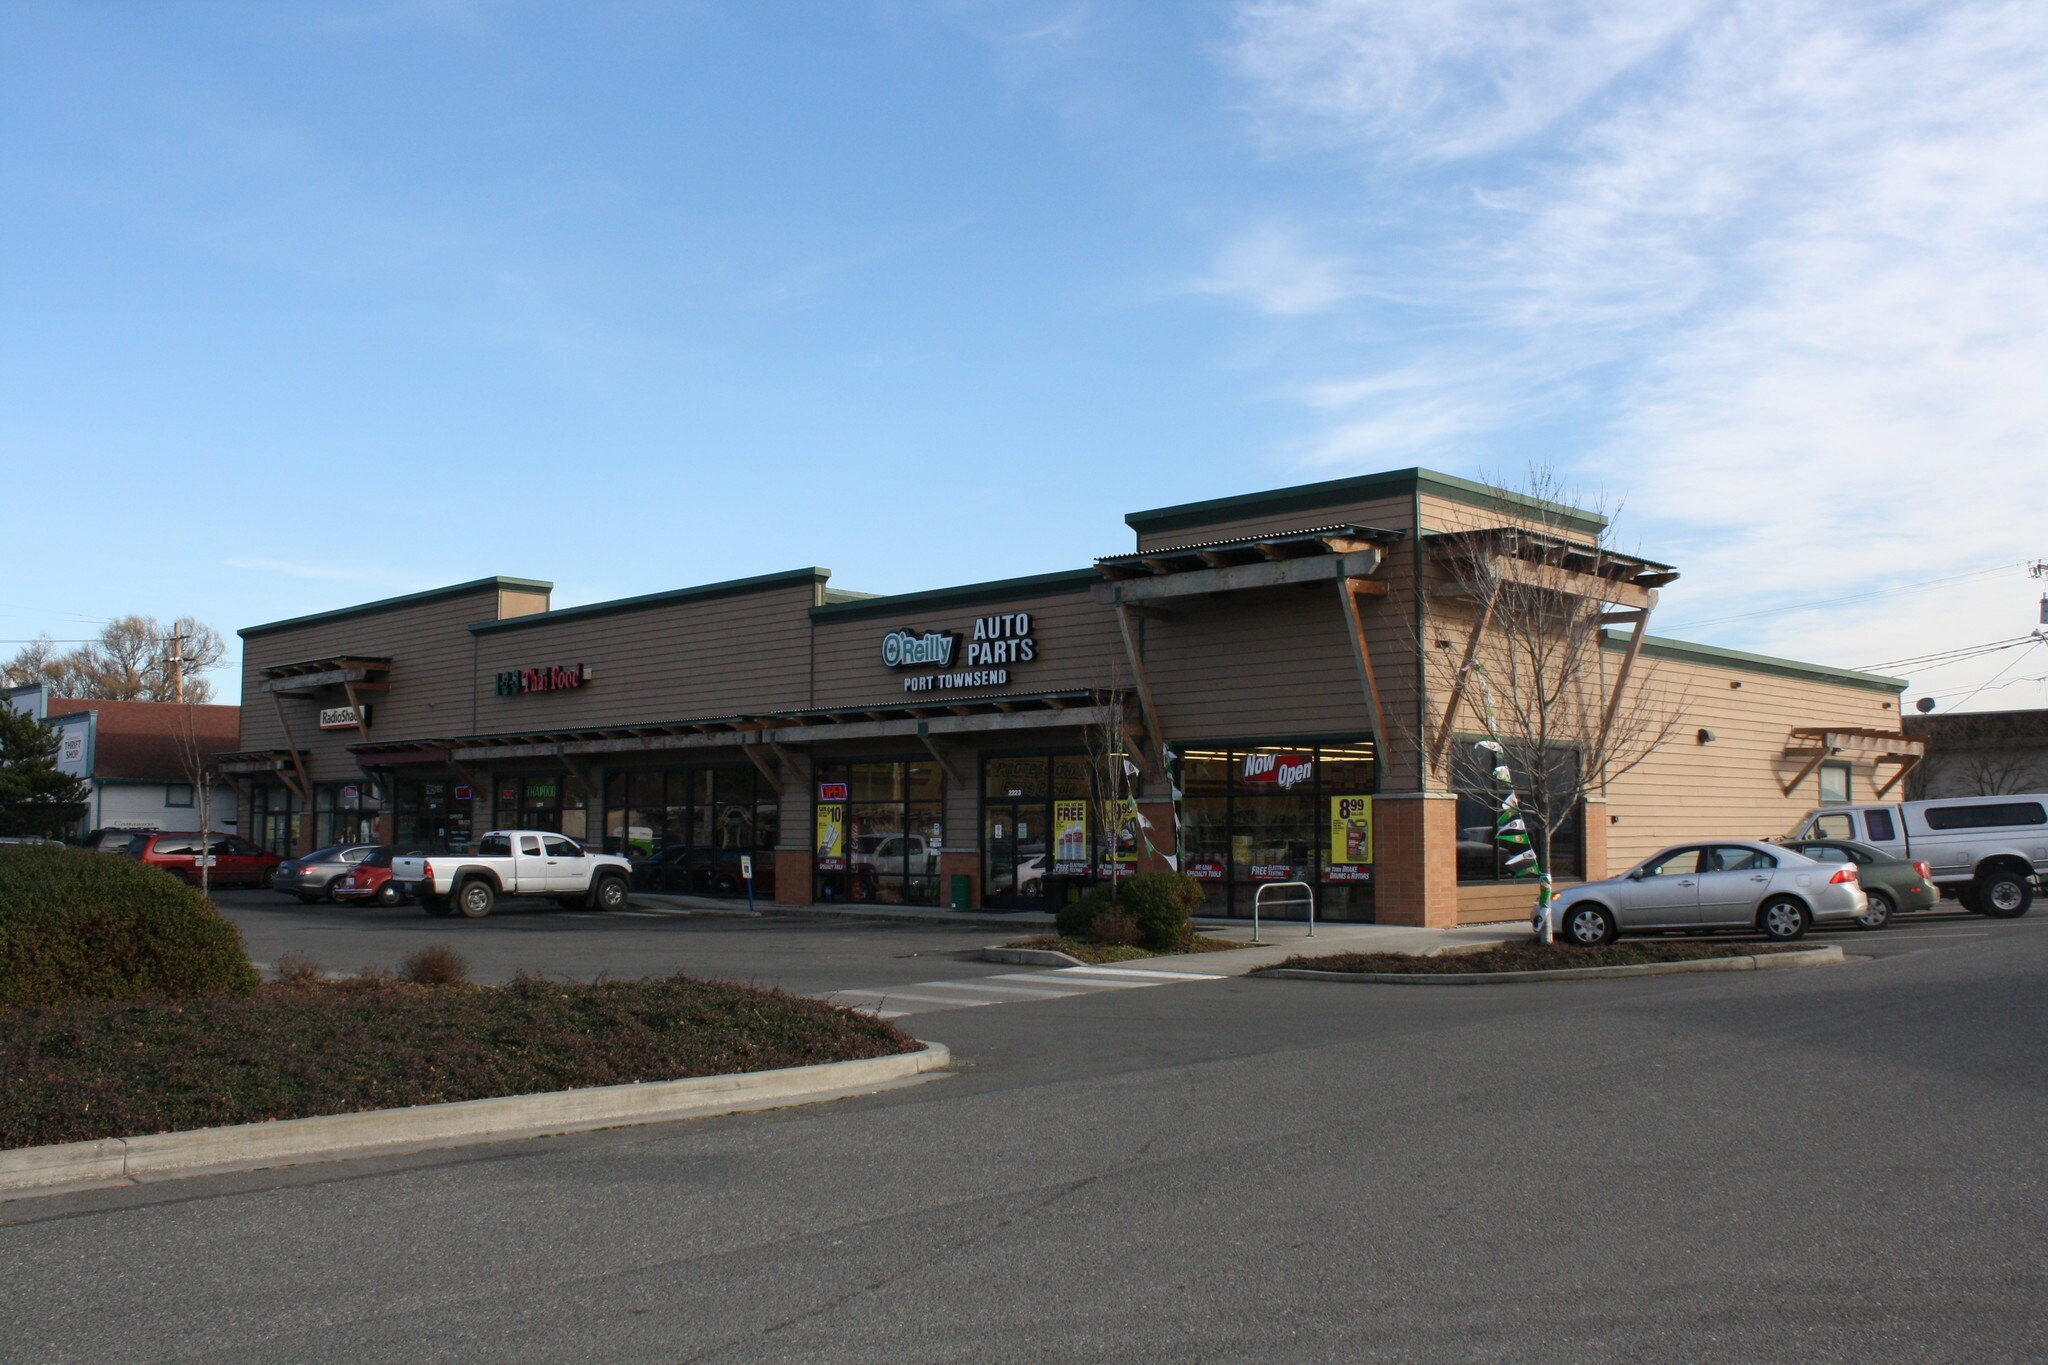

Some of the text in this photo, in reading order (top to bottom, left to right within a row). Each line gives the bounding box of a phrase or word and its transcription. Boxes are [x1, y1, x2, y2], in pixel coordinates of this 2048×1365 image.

[973, 613, 1028, 641] AUTO
[882, 631, 953, 667] O'Reilly
[967, 638, 1033, 666] PARTS
[521, 667, 548, 693] Thai
[550, 663, 583, 690] Food
[904, 669, 1008, 692] PORT TOWNSEND
[322, 708, 360, 724] RadioShac
[64, 740, 81, 750] THRIFT
[65, 749, 79, 760] SHOP
[1244, 754, 1313, 789] Now Open
[822, 785, 847, 799] OPEN
[1057, 807, 1084, 821] FREE
[1056, 863, 1069, 873] FREE
[1251, 865, 1268, 875] FREE
